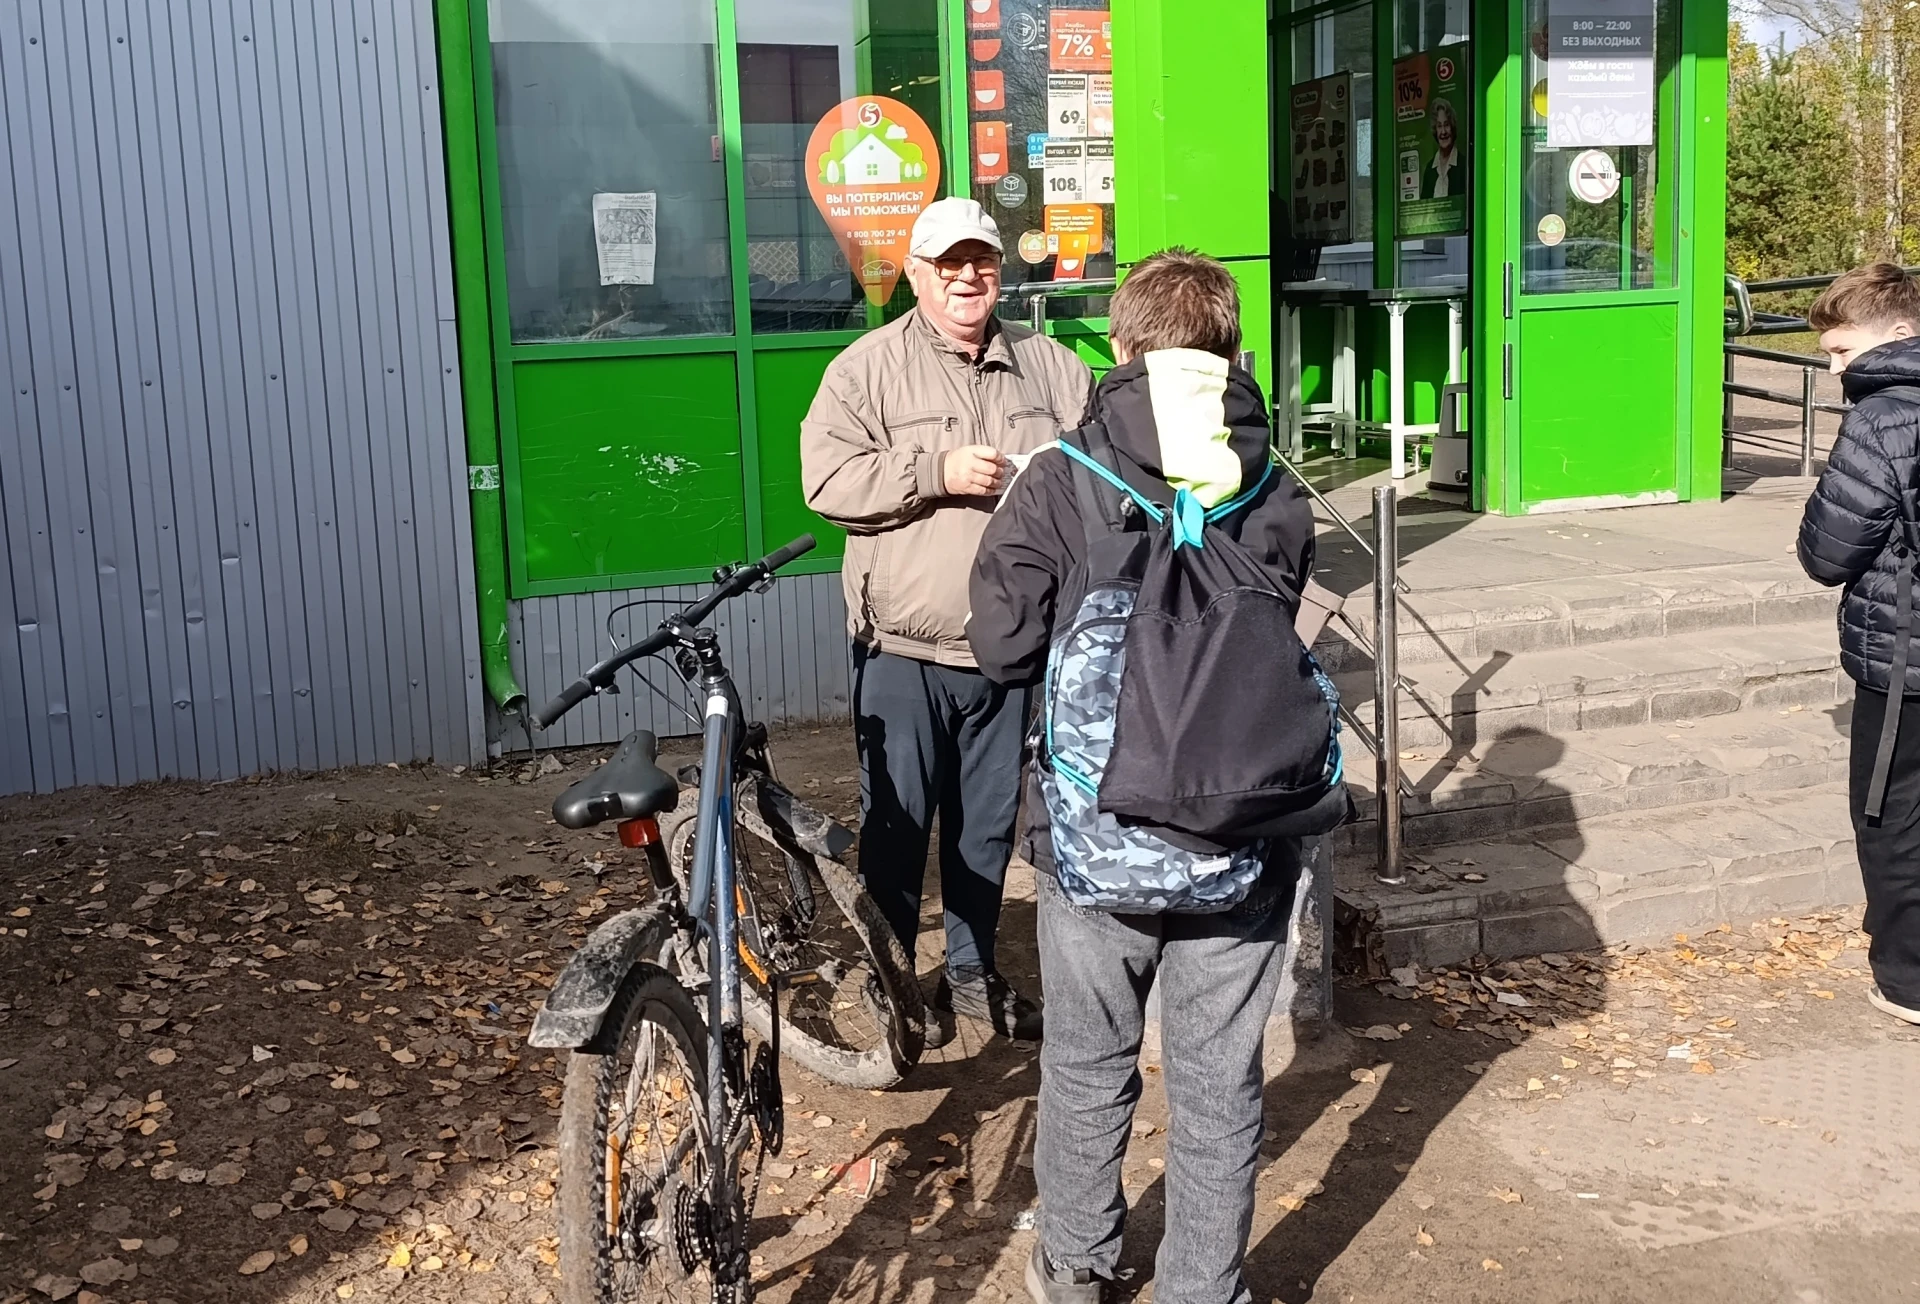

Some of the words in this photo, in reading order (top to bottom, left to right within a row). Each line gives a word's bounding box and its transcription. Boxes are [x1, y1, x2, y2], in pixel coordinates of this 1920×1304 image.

[1573, 21, 1594, 30] 8:00
[1606, 21, 1631, 30] 22:00
[1057, 35, 1094, 56] 7%
[1562, 37, 1580, 46] БЕЗ
[1582, 36, 1641, 47] ВЫХОДНЫХ
[1606, 61, 1634, 70] гости
[1567, 72, 1607, 82] каждый
[1609, 73, 1635, 82] день!
[1398, 79, 1422, 103] 10%
[864, 105, 878, 126] 5
[1059, 110, 1080, 124] 69
[1049, 177, 1077, 192] 108
[826, 193, 842, 204] ВЫ
[845, 191, 924, 204] ПОТЕРЯЛИСЬ?
[830, 207, 851, 217] МЫ
[854, 204, 921, 216] ПОМОЖЕМ!
[853, 230, 869, 238] 800
[870, 229, 884, 238] 700
